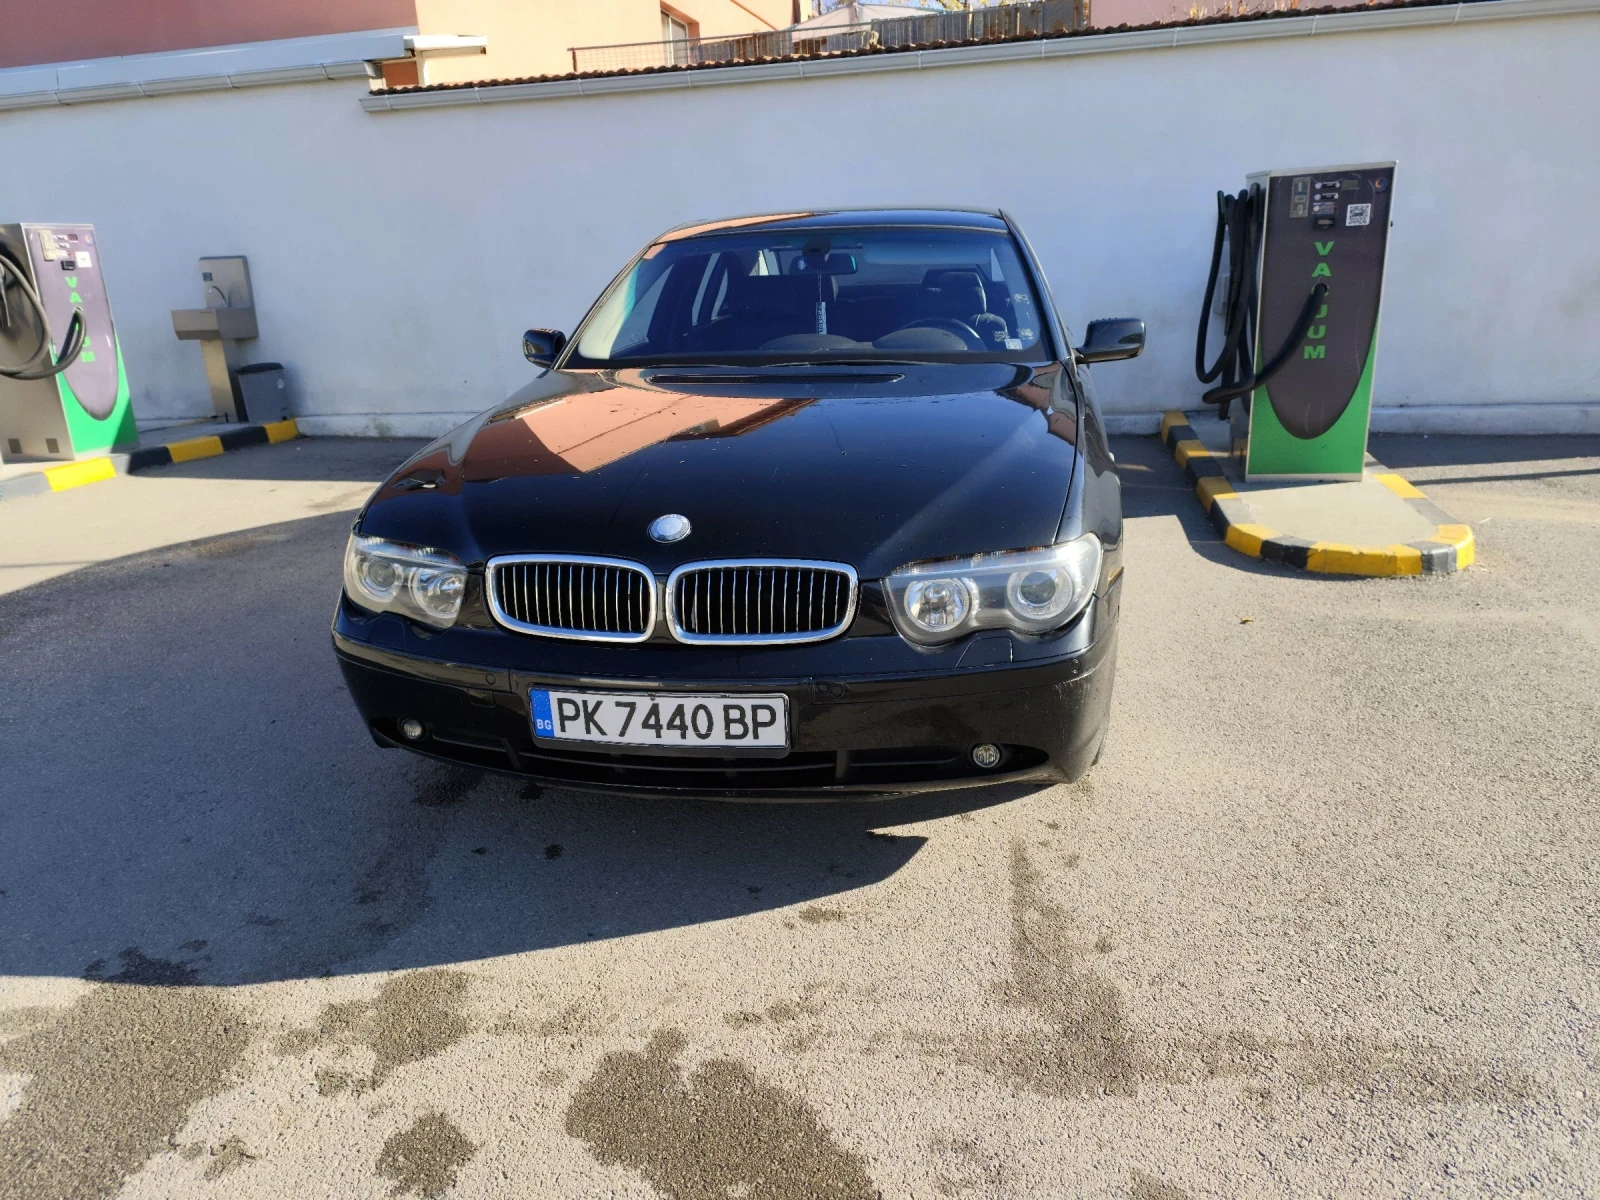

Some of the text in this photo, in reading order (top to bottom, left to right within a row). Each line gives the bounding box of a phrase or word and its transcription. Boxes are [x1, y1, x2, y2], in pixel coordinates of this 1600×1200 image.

[536, 718, 552, 731] BG
[556, 697, 777, 741] PK 7440 BP
